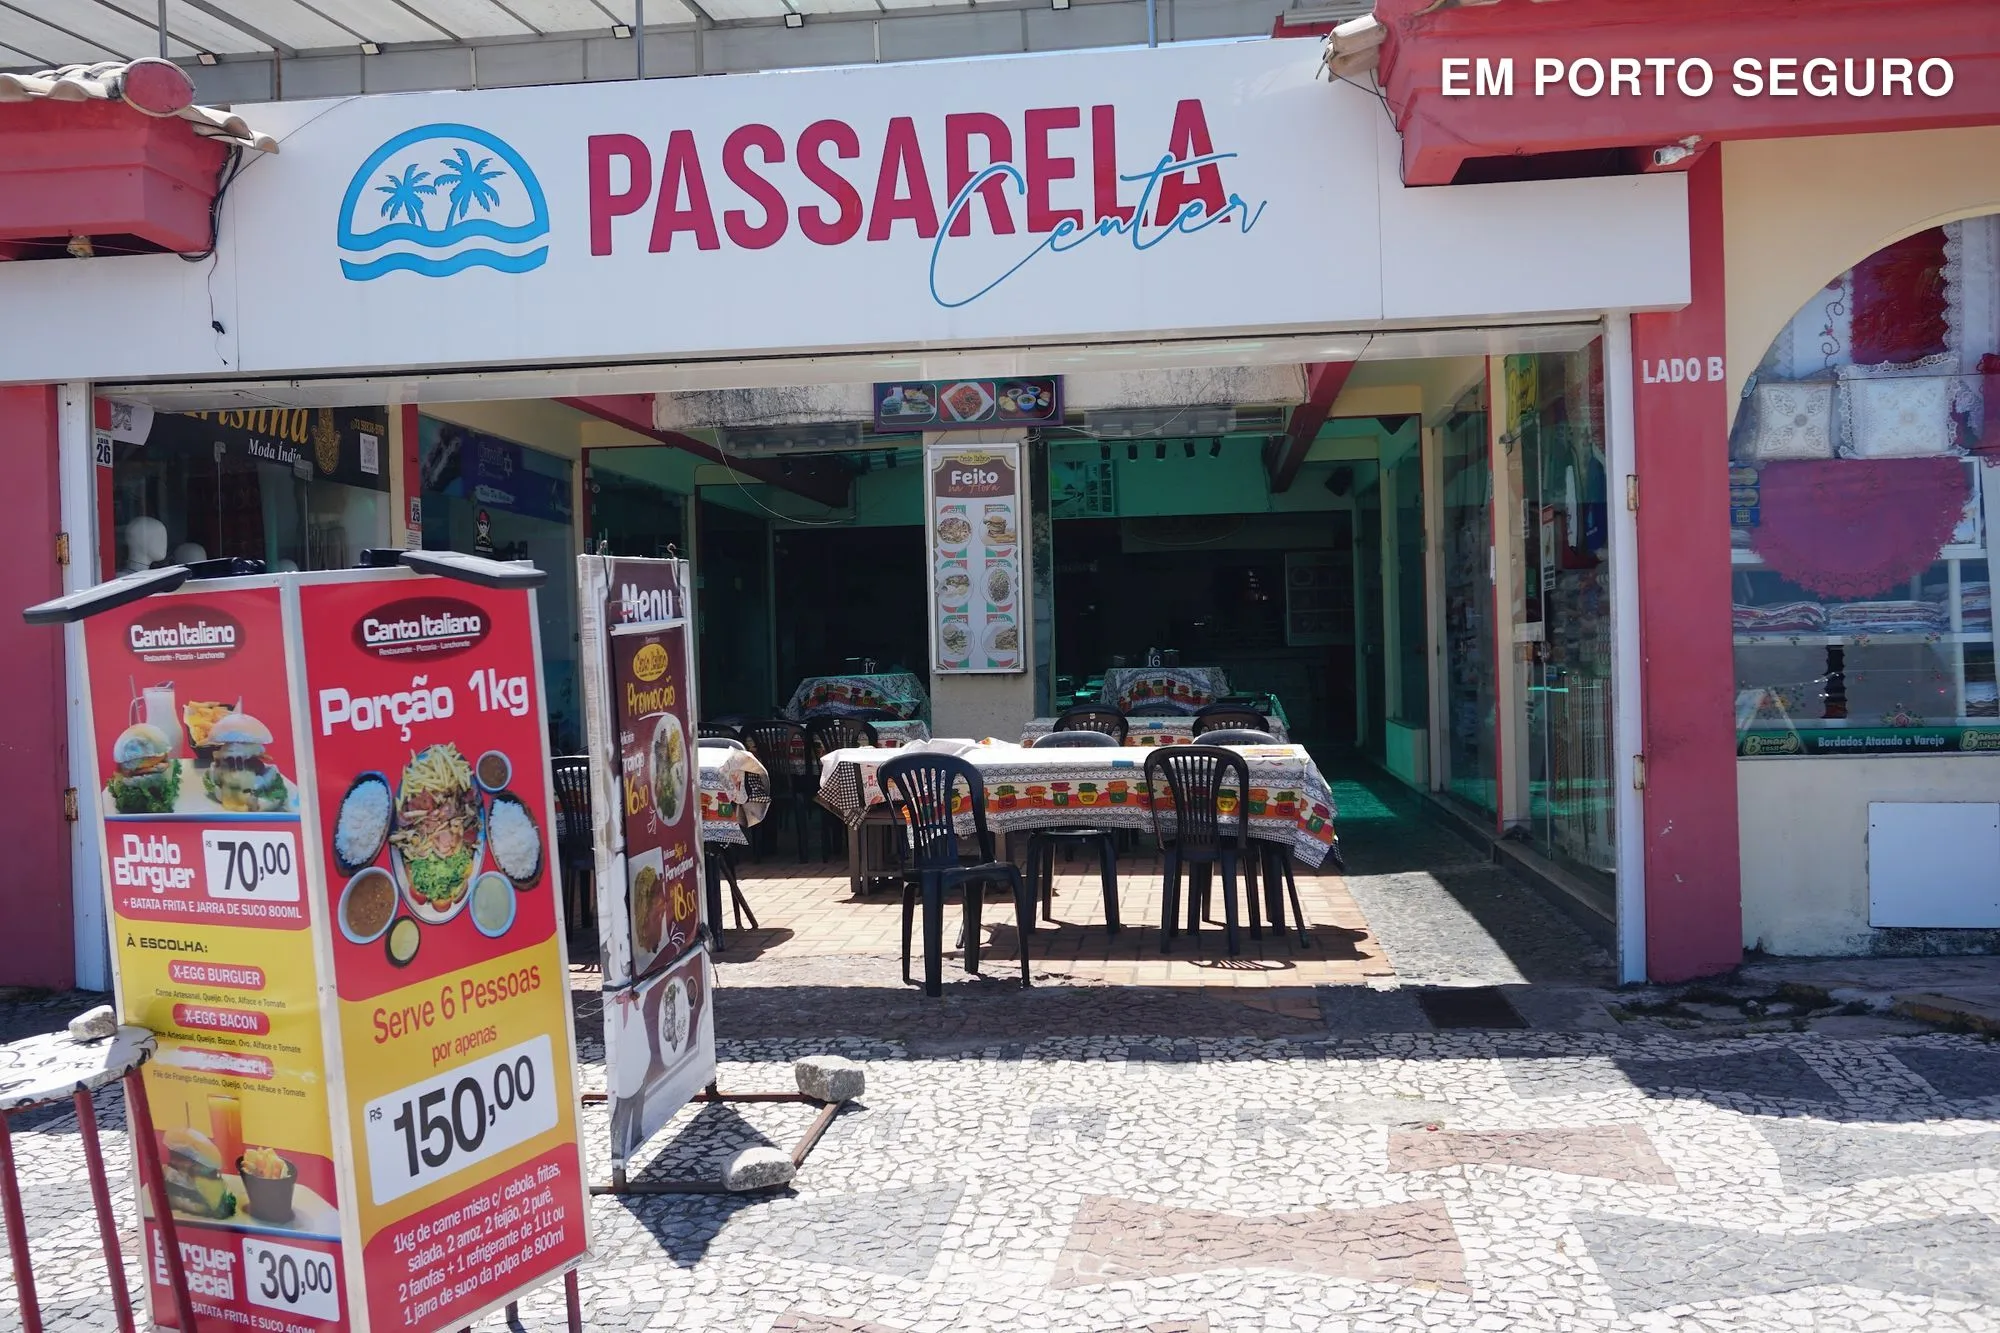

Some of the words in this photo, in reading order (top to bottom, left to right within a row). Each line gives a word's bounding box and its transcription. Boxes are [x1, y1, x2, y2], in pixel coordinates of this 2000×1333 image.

[587, 98, 1232, 257] PASSARELA
[929, 151, 1268, 308] Center
[1642, 357, 1702, 385] LADO
[1706, 355, 1725, 382] B
[96, 443, 111, 465] 26
[248, 438, 275, 460] Moda
[951, 468, 999, 486] Feito
[621, 583, 673, 623] Menu
[130, 624, 179, 649] Canto
[178, 620, 236, 645] Italiano
[363, 618, 420, 643] Canto
[420, 612, 481, 638] Italiano
[864, 662, 876, 674] 17
[1147, 654, 1161, 668] 16
[319, 674, 454, 743] Porção
[468, 668, 529, 717] 1kg
[626, 675, 675, 717] Promoção
[1818, 736, 1863, 748] Bordados
[1865, 734, 1903, 747] Atacado
[1905, 737, 1912, 745] e
[1914, 733, 1945, 748] Varejo
[123, 834, 181, 865] Dublo
[217, 841, 291, 892] 70,00
[113, 856, 196, 894] Burguer
[130, 898, 162, 911] BATATA
[162, 899, 187, 912] FRITA
[188, 900, 194, 912] E
[196, 901, 226, 914] JARRA
[227, 903, 240, 916] DE
[241, 904, 268, 917] SUCO
[268, 906, 302, 919] 800ML
[126, 932, 136, 948] À
[140, 938, 209, 953] ESCOLHA:
[172, 964, 206, 981] X-EGG
[206, 966, 262, 986] BURGUER
[184, 1008, 218, 1026] X-EGG
[218, 1012, 258, 1031] BACON
[372, 999, 436, 1045] Serve
[440, 985, 456, 1021] 6
[460, 965, 542, 1015] Pessoas
[432, 1042, 452, 1068] por
[455, 1024, 498, 1058] apenas
[369, 1106, 382, 1123] R$
[393, 1054, 536, 1178] 150,00
[393, 1234, 416, 1254] 1kg
[416, 1224, 431, 1243] de
[432, 1211, 461, 1236] carne
[462, 1196, 490, 1222] mista
[491, 1186, 503, 1209] c/
[504, 1174, 536, 1201] cebola,
[536, 1161, 561, 1185] fritas,
[408, 1244, 446, 1273] salada,
[446, 1234, 456, 1252] 2
[456, 1226, 484, 1250] arroz,
[485, 1216, 494, 1235] 2
[494, 1204, 522, 1231] feijão,
[522, 1198, 530, 1216] 2
[531, 1186, 554, 1212] purê,
[398, 1282, 408, 1303] 2
[408, 1268, 446, 1298] farofas
[447, 1262, 455, 1276] +
[456, 1255, 465, 1274] 1
[466, 1233, 520, 1268] refrigerante
[520, 1220, 534, 1240] de
[534, 1214, 542, 1232] 1
[542, 1210, 552, 1228] Lt
[552, 1205, 566, 1221] ou
[258, 1250, 333, 1304] 30,00
[404, 1306, 412, 1326] 1
[412, 1296, 439, 1326] jarra
[439, 1288, 454, 1307] de
[454, 1278, 478, 1299] suco
[479, 1266, 494, 1286] da
[494, 1254, 520, 1281] polpa
[521, 1242, 534, 1262] de
[534, 1225, 565, 1256] 800ml
[224, 1308, 250, 1326] FRITA
[250, 1315, 258, 1328] E
[258, 1316, 284, 1333] SUCO
